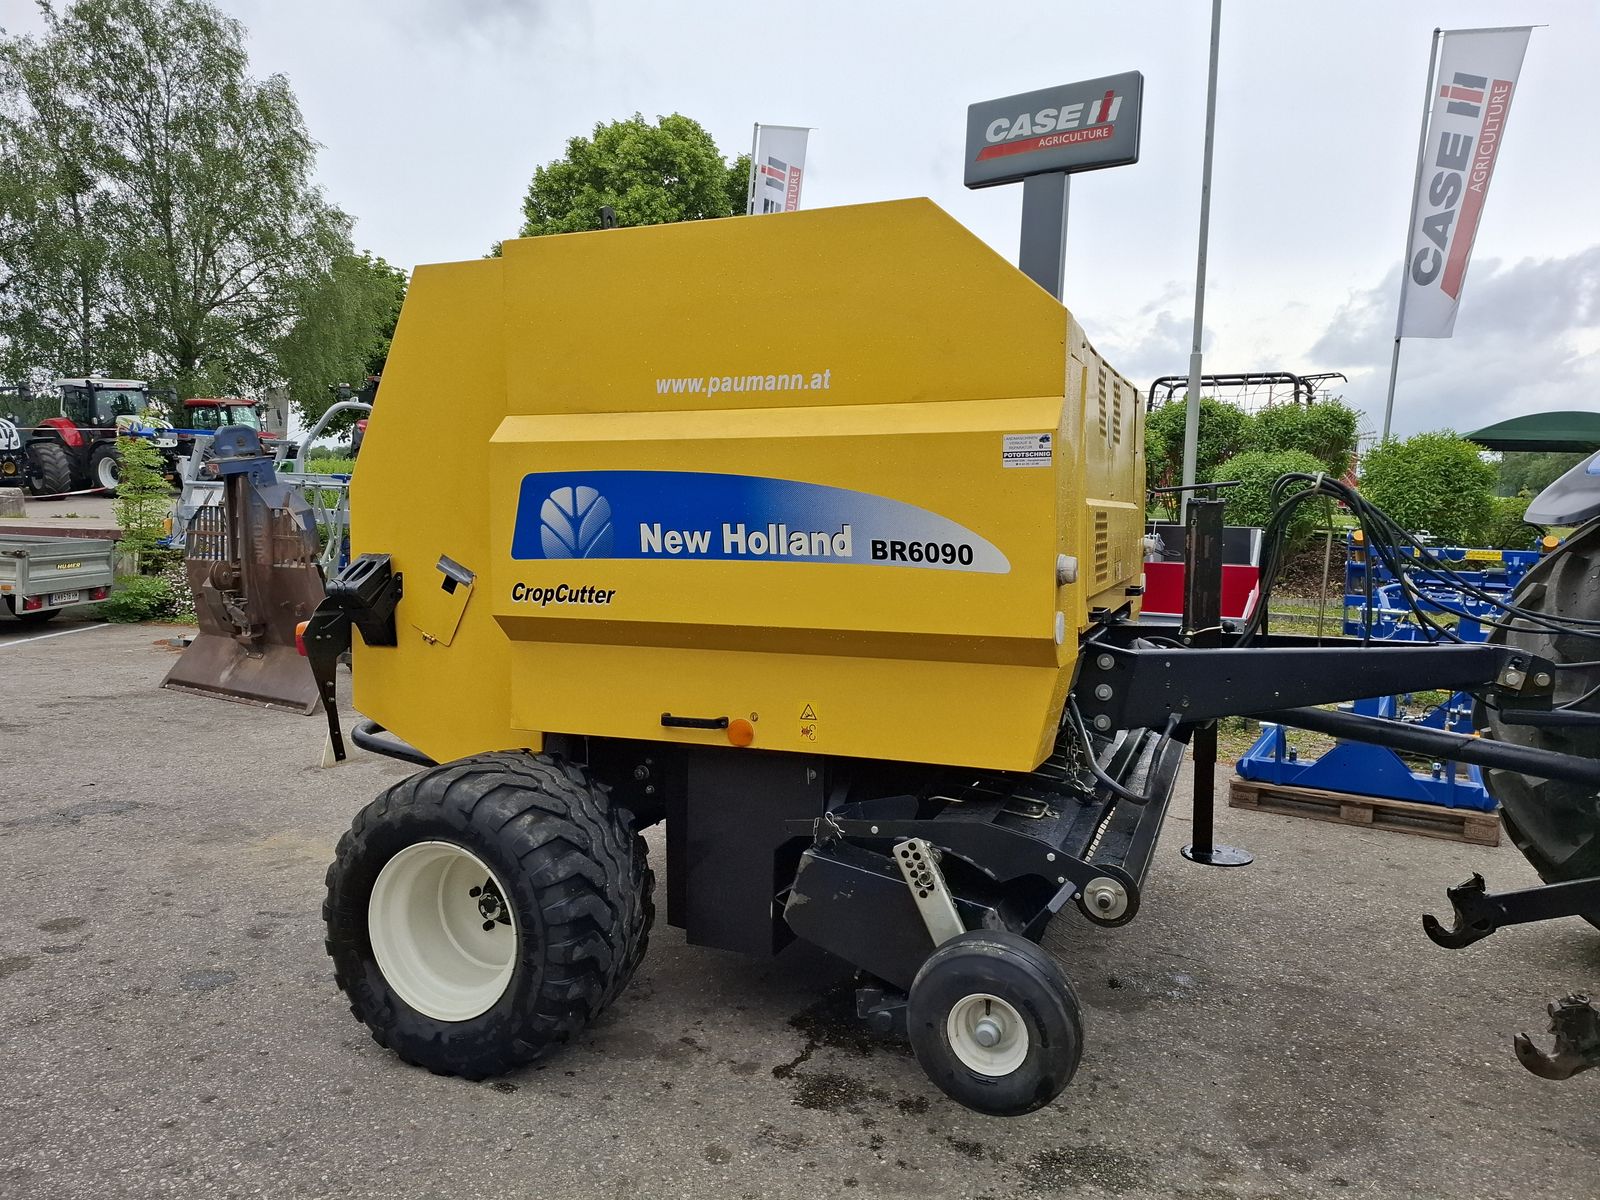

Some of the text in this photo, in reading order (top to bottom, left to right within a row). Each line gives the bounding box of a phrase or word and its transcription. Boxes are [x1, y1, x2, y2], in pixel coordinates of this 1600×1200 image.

[985, 103, 1085, 143] CASE
[1038, 127, 1109, 148] AGRICULTURE
[1470, 84, 1509, 193] AGRICULTURE
[788, 170, 800, 212] ULTURE
[1412, 131, 1474, 286] CASE
[656, 369, 831, 398] www.paumann.at
[640, 523, 974, 566] New Holland BR6090
[511, 582, 617, 608] CropCutter
